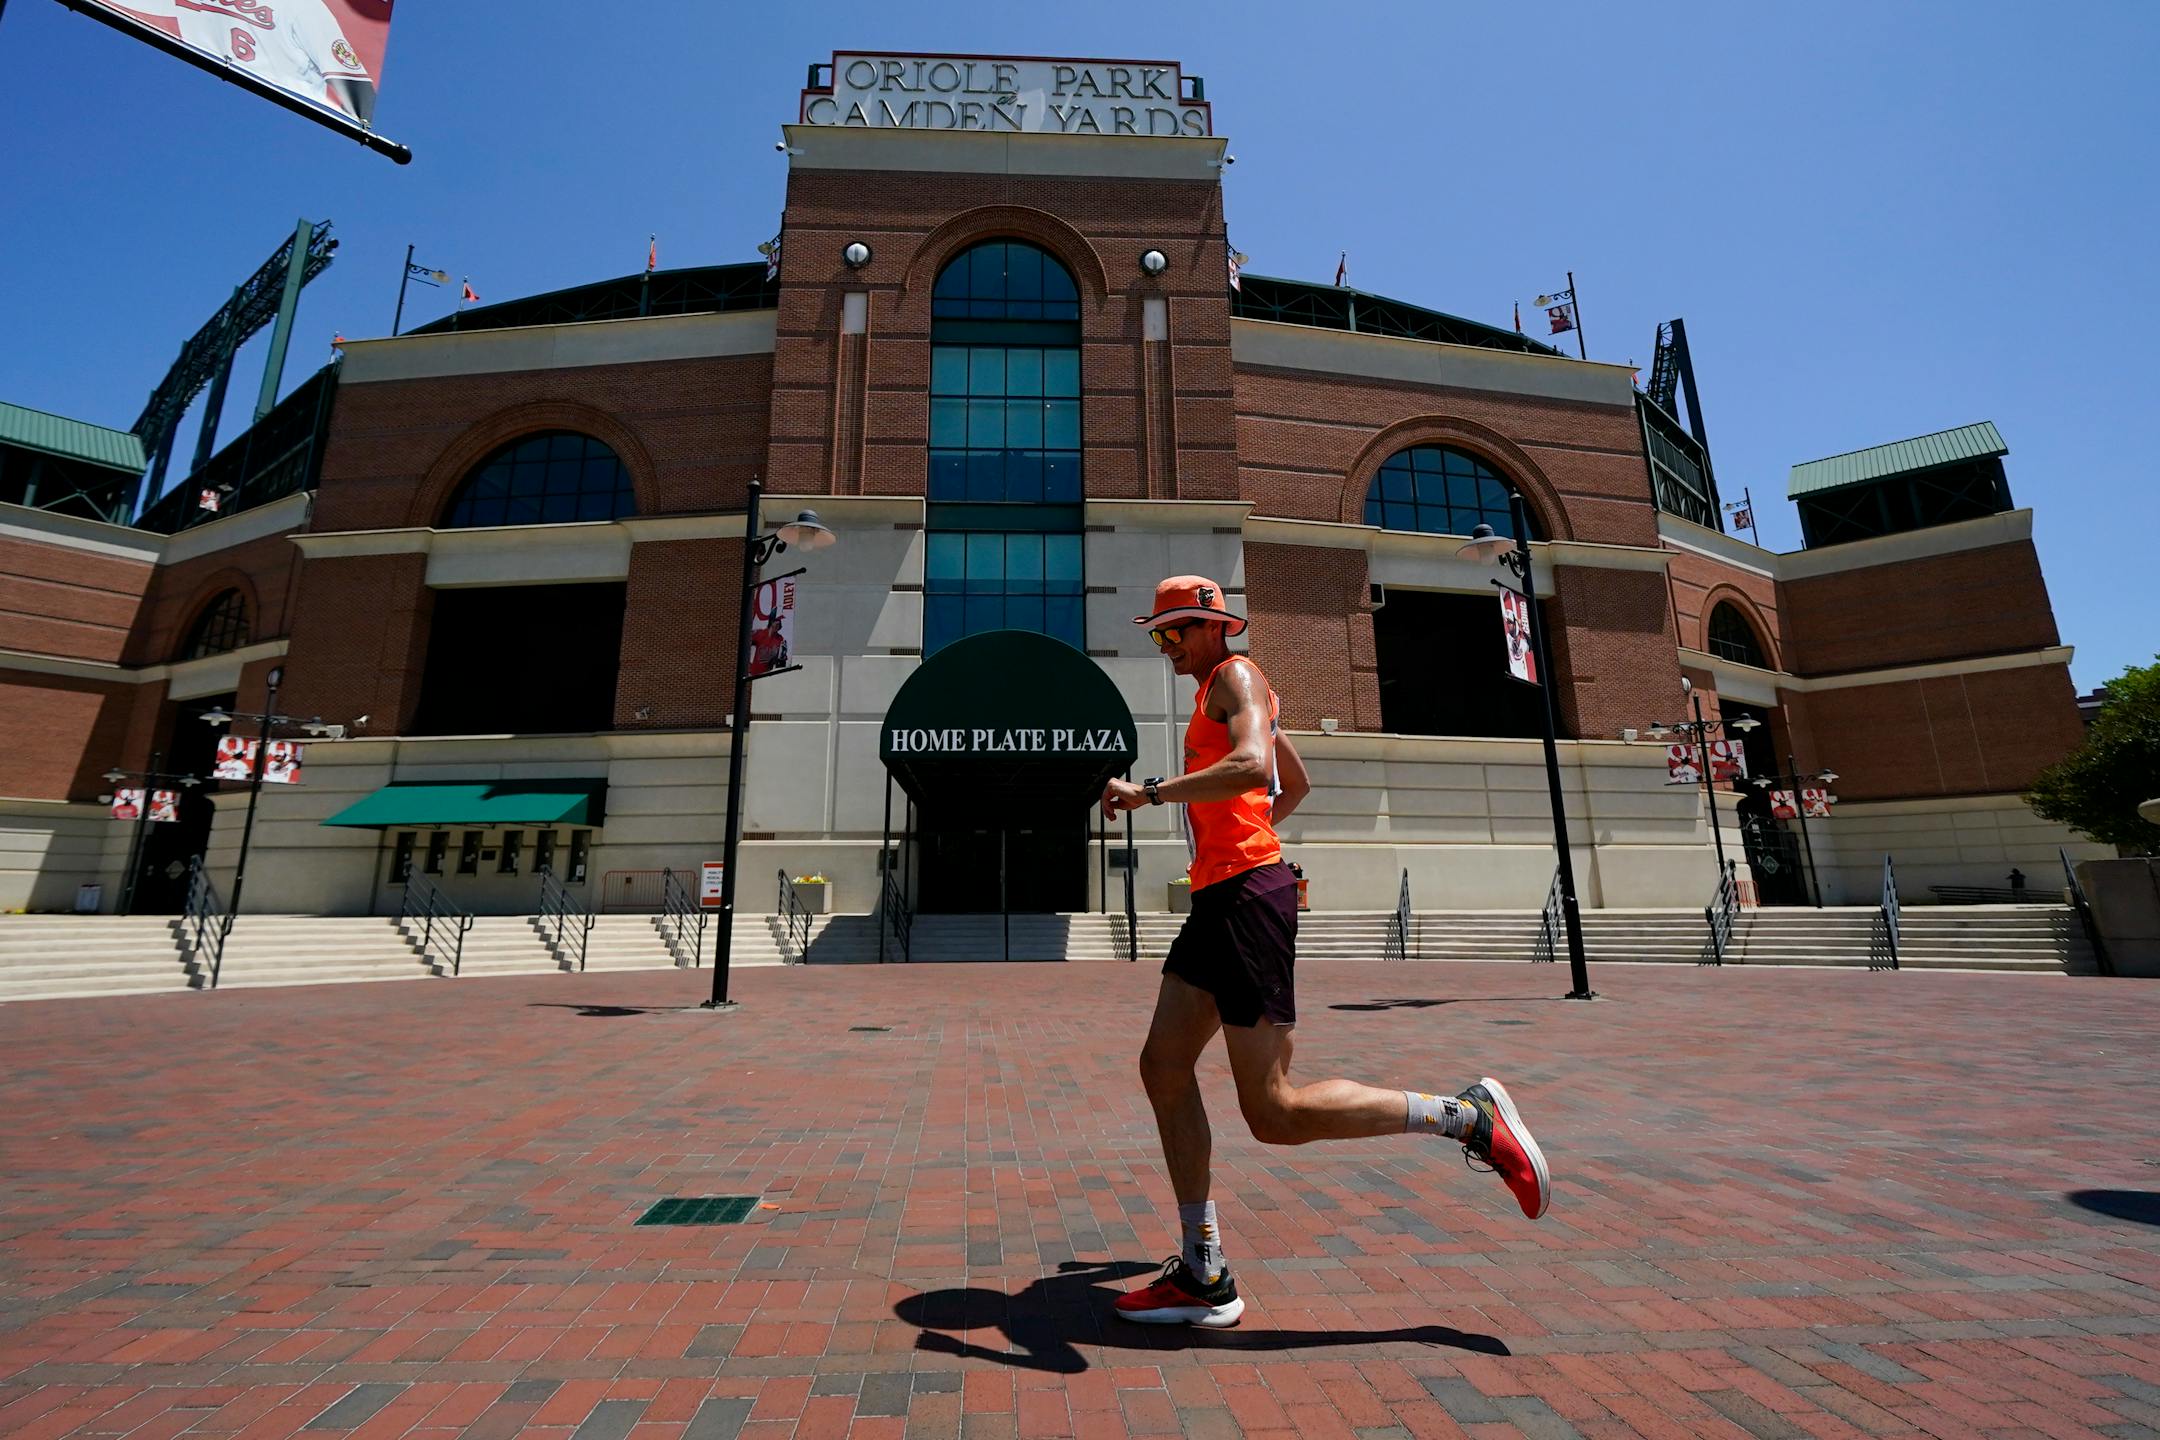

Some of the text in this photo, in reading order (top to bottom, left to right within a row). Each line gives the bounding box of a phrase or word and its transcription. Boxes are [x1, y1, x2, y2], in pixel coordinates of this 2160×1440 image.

[230, 27, 256, 62] 6
[845, 60, 1172, 99] ORIOLE PARK
[806, 97, 1204, 136] CAMDEN YARDS
[783, 582, 795, 610] ADLEY
[891, 729, 1128, 752] HOME PLATE PLAZA
